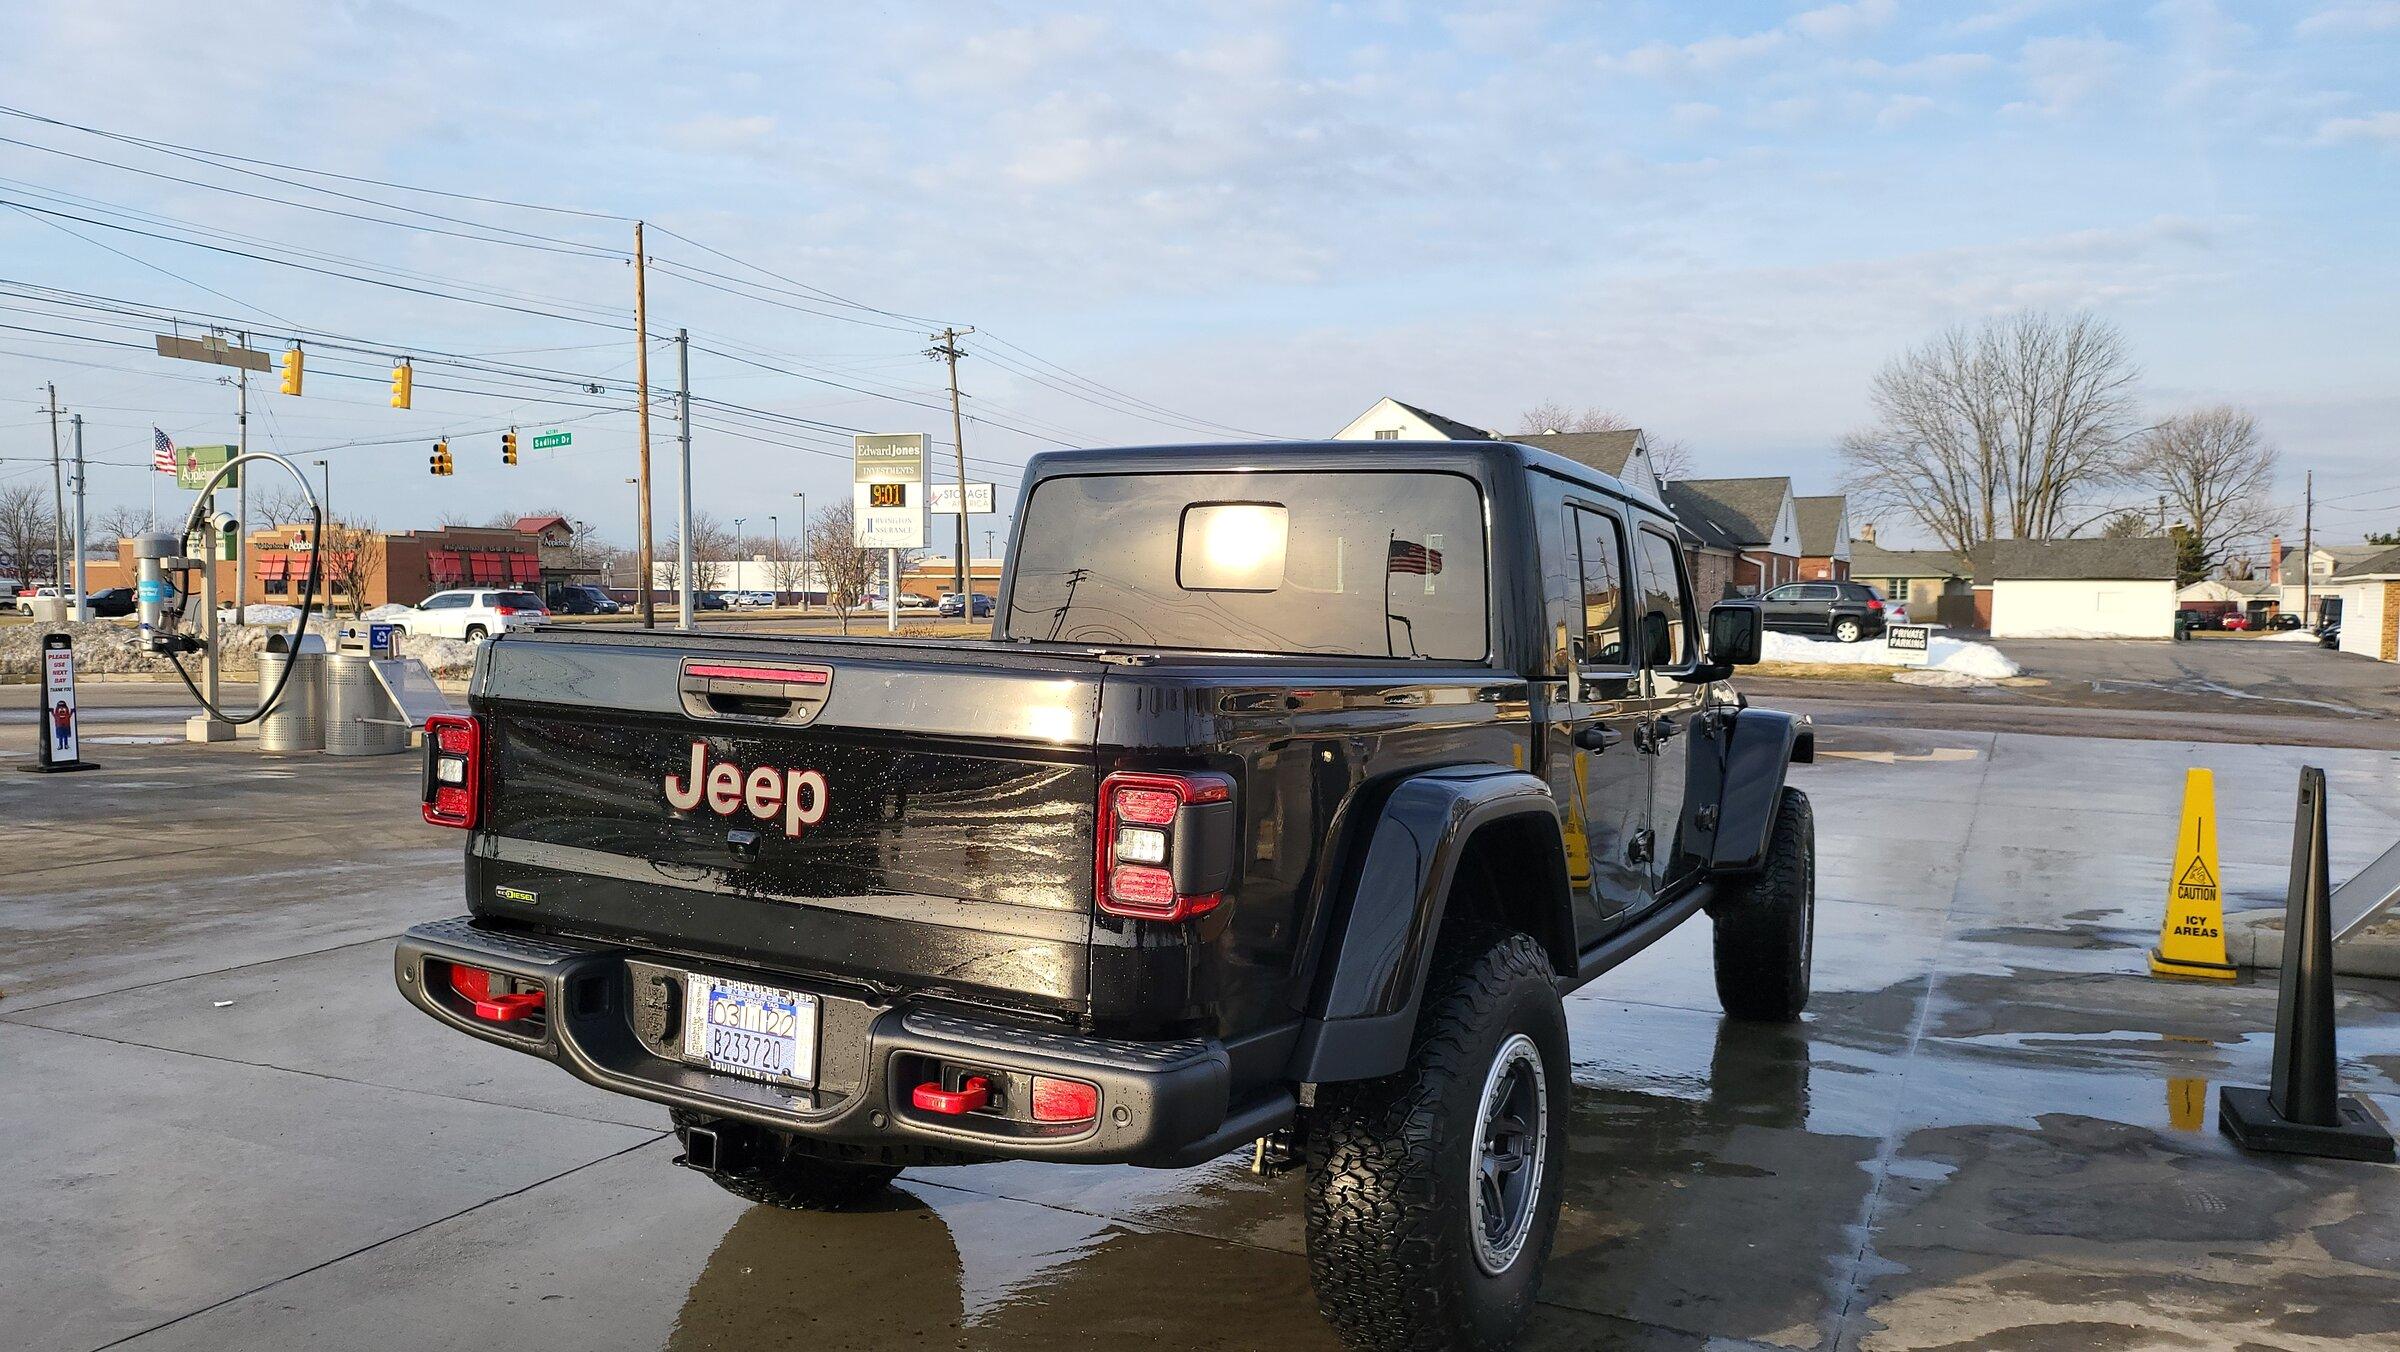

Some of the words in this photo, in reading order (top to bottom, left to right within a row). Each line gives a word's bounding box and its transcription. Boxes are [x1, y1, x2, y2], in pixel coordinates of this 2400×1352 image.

[863, 466, 915, 475] INVESTMENTS
[873, 484, 900, 505] 9:01
[943, 489, 988, 499] STOAGE
[1891, 628, 1925, 639] PRIVATE
[1890, 637, 1926, 649] PARKING
[665, 740, 829, 836] Jeep
[2177, 886, 2217, 901] CAUTION
[2185, 915, 2208, 926] ICY
[2173, 926, 2219, 938] AREAS
[687, 972, 721, 985] CROSS
[726, 980, 780, 997] CHRYSLER
[786, 989, 813, 1003] JEEP
[714, 1028, 781, 1070] B233720
